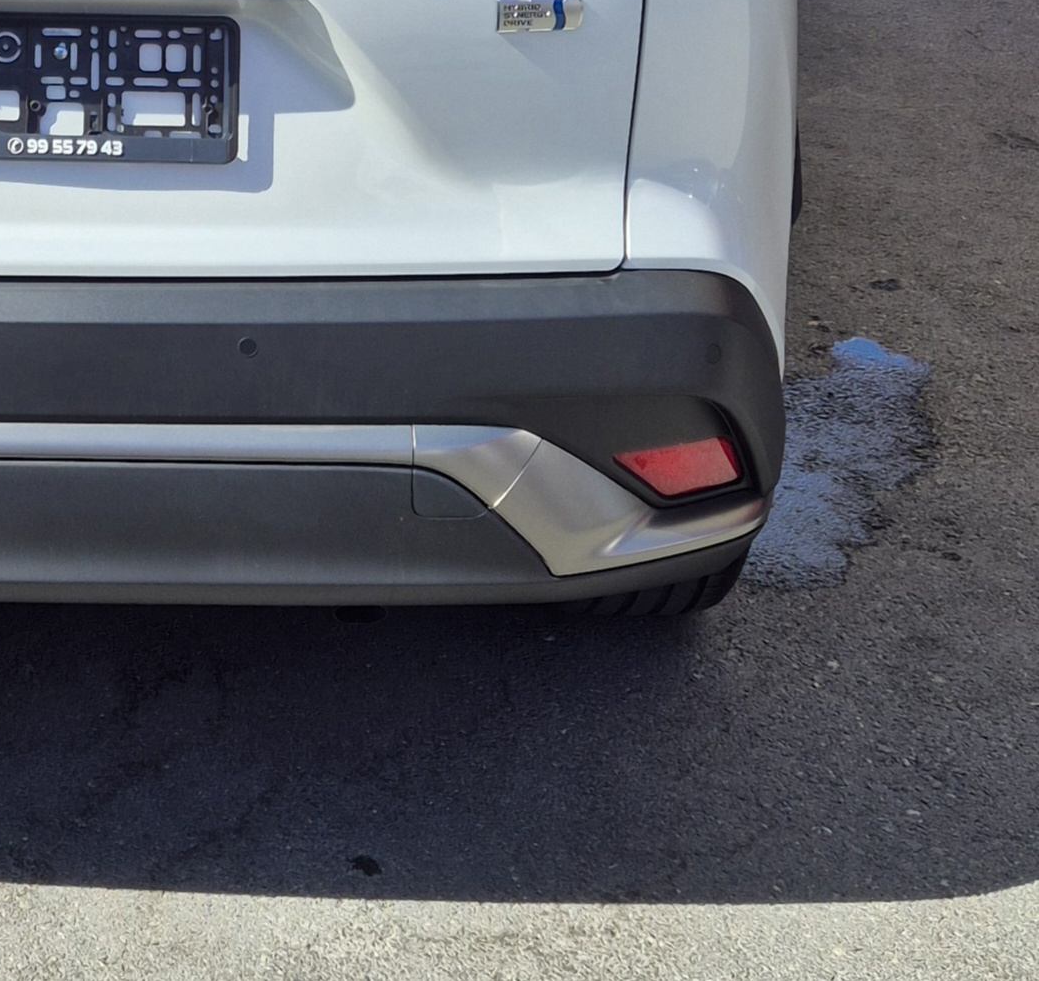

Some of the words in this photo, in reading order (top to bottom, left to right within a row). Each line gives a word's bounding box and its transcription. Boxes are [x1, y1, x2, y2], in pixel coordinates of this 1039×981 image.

[503, 11, 549, 19] SYNERGY
[503, 19, 533, 27] DRIVE
[26, 138, 49, 154] 99
[52, 139, 74, 155] 55
[76, 139, 98, 155] 79
[100, 140, 123, 156] 43
